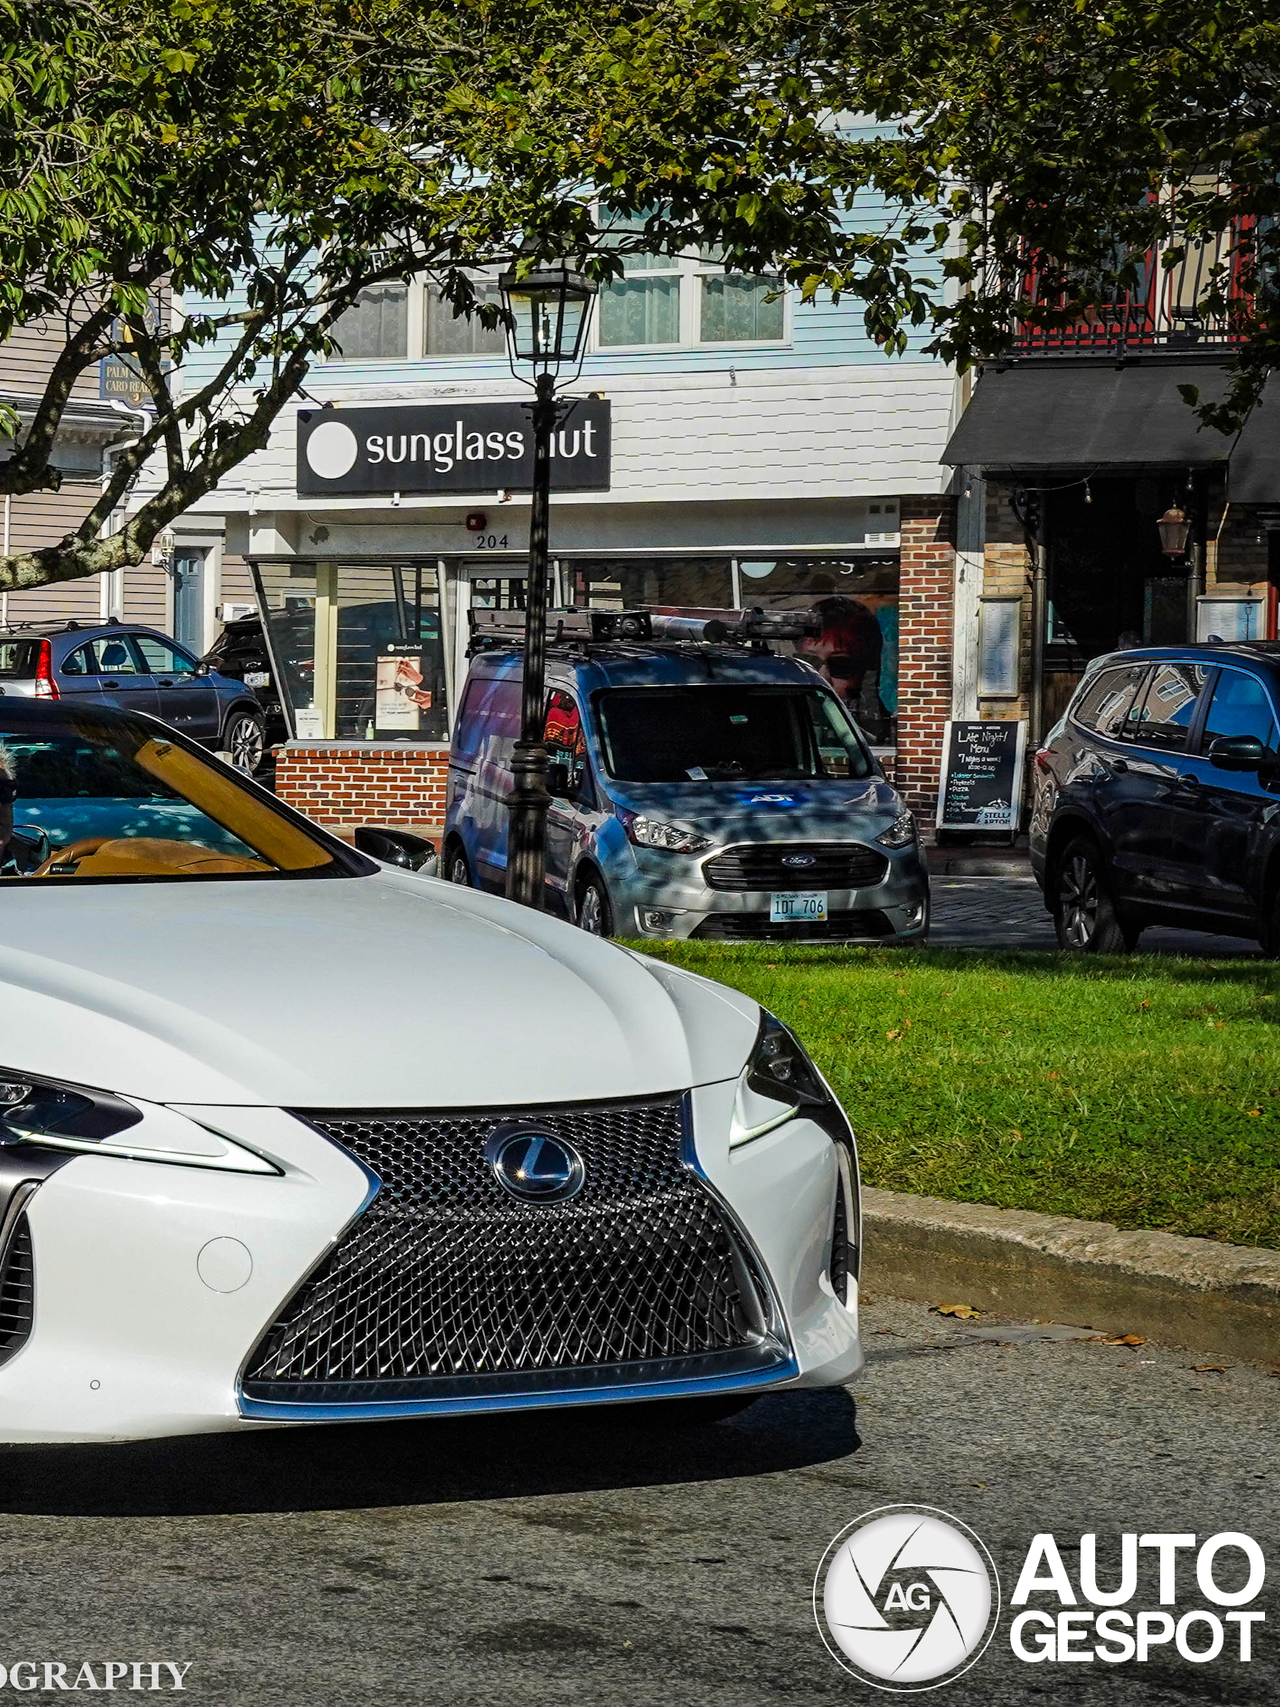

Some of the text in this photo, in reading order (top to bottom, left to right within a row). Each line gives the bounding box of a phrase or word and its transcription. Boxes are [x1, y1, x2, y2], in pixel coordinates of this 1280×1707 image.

[106, 366, 129, 378] PALM
[106, 380, 128, 391] CARD
[366, 420, 525, 474] sunglass
[477, 535, 509, 549] 204
[751, 794, 795, 803] ADT
[775, 900, 824, 914] 1DT 706
